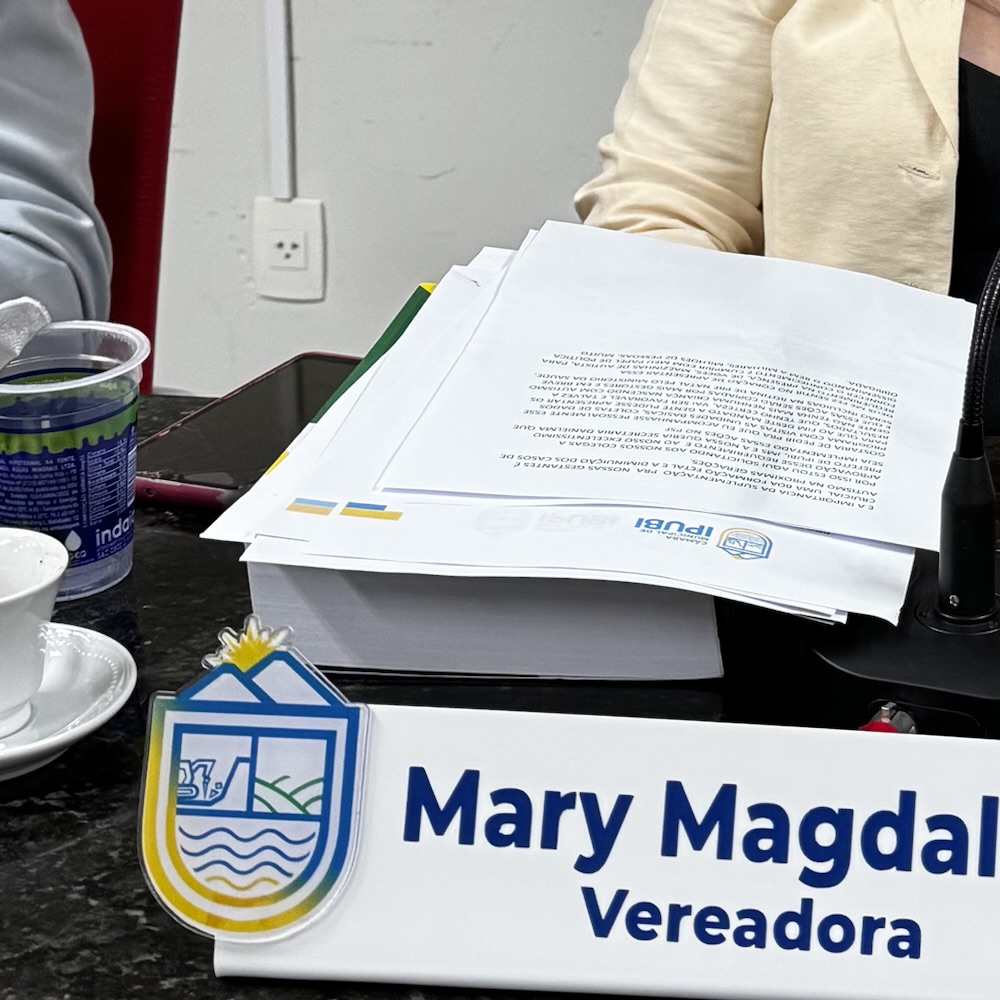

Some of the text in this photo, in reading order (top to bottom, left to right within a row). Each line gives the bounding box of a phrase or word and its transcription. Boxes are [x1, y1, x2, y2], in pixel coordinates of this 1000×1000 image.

[634, 518, 714, 537] IPUBI
[657, 531, 709, 541] MUNICIPAL
[404, 767, 634, 874] Mary
[581, 887, 921, 959] Vereadora
